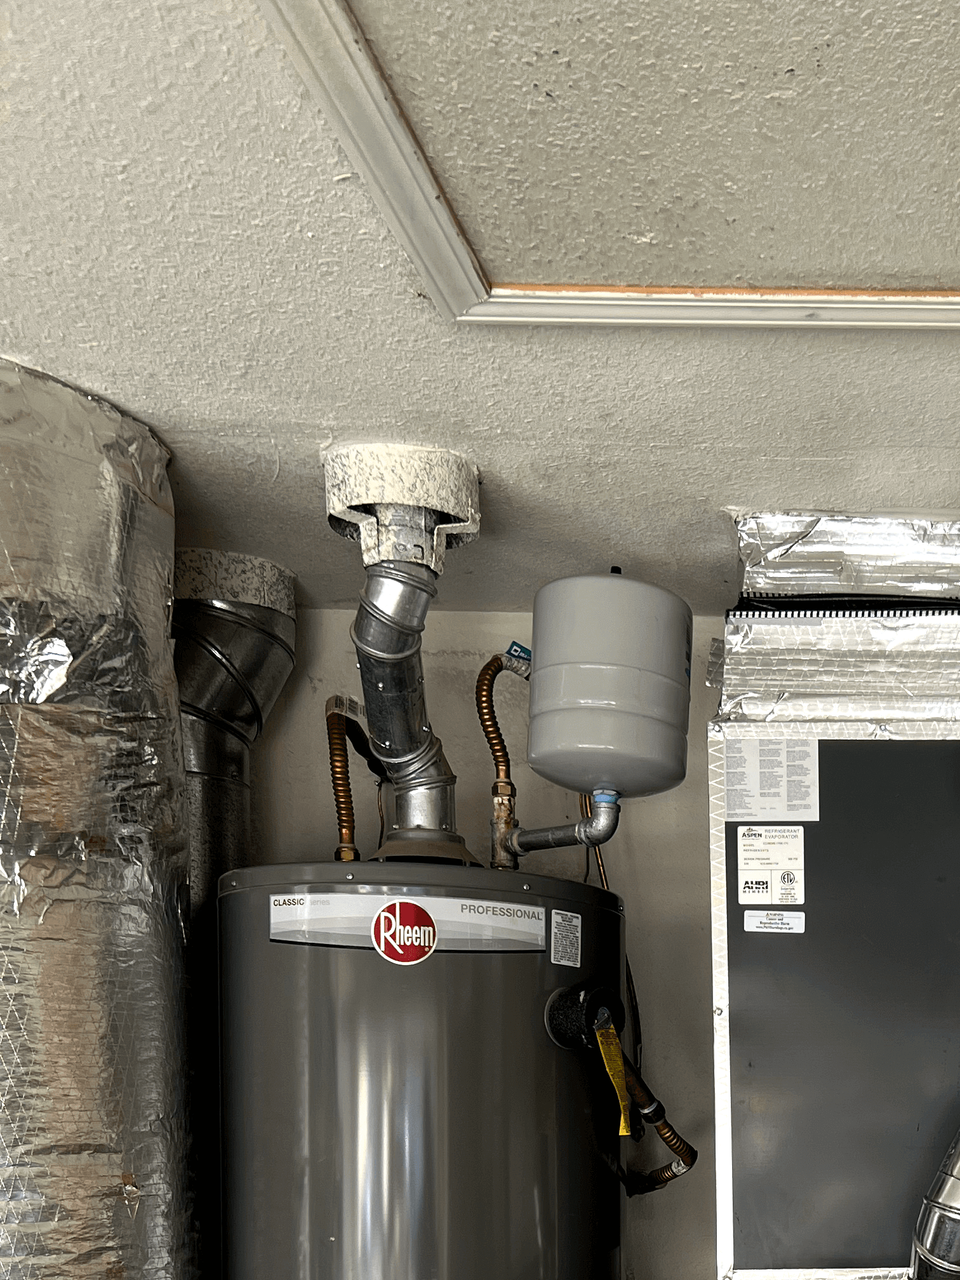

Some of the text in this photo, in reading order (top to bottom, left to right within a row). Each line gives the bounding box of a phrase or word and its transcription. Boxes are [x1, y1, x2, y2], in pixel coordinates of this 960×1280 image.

[273, 898, 305, 907] CLASSIC
[461, 904, 542, 920] PROFESSIONAL
[381, 902, 434, 954] Rheem
